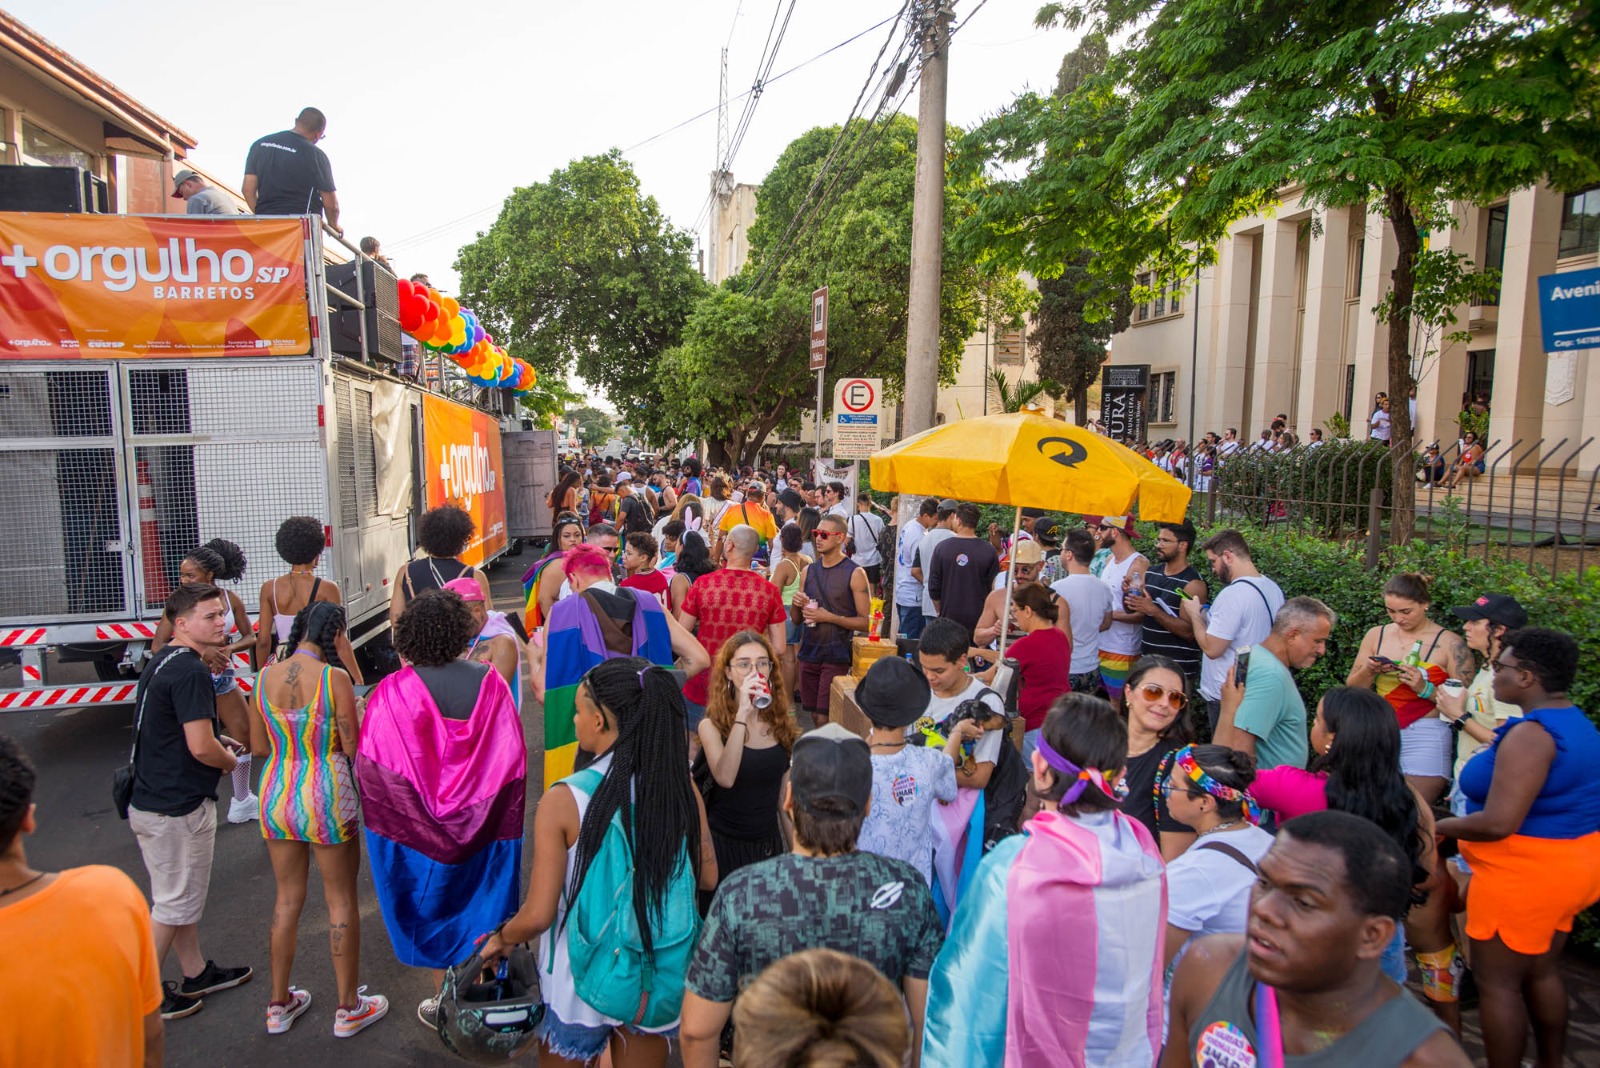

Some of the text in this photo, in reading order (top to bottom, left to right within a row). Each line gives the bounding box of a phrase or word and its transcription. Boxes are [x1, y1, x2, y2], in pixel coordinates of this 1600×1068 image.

[255, 266, 290, 284] SP
[153, 286, 255, 300] BARRETOS
[1551, 280, 1600, 301] Aveni
[850, 385, 866, 406] E
[1105, 392, 1111, 402] DE
[1127, 392, 1135, 435] MUNICIPAL
